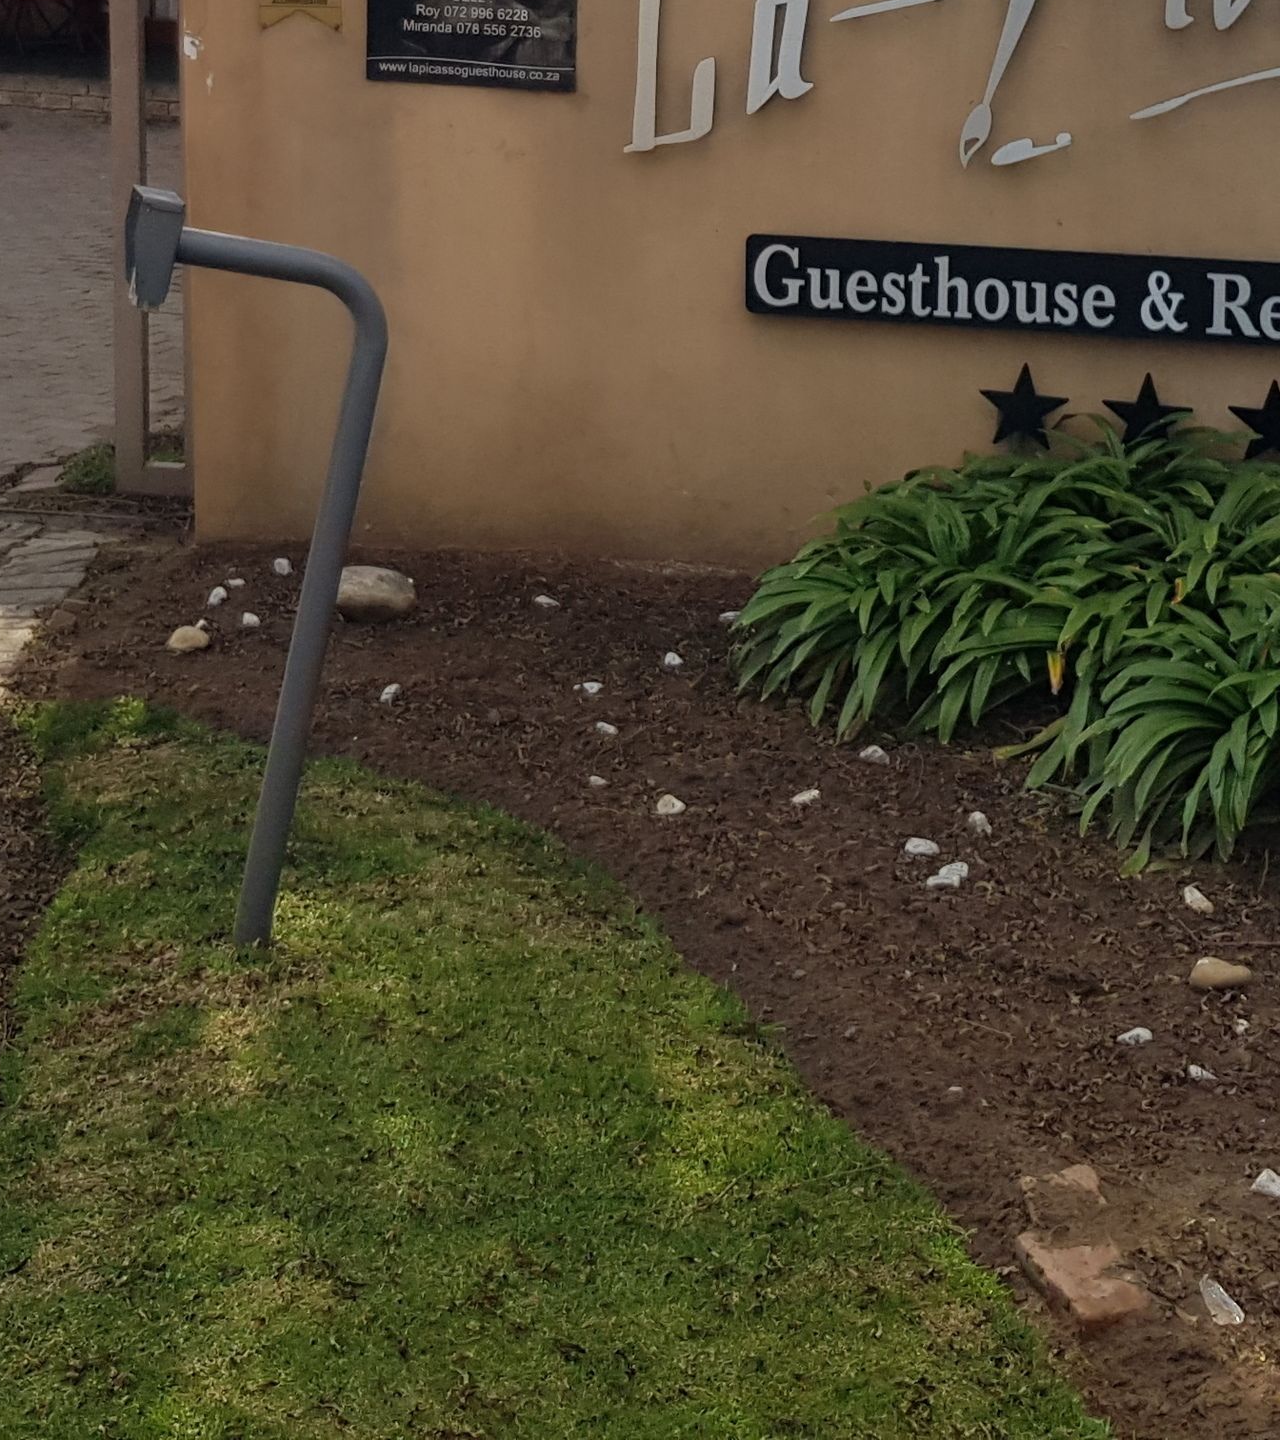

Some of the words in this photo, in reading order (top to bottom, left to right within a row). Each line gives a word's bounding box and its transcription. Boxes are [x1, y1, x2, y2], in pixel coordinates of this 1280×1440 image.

[415, 3, 441, 19] Roy
[444, 5, 468, 18] 072
[471, 7, 494, 20] 996
[497, 8, 529, 21] 6228
[403, 19, 453, 33] Miranda
[456, 22, 480, 34] 078
[483, 23, 507, 36] 556
[510, 25, 541, 38] 2736
[379, 61, 560, 81] wwwlapicassoguesthouse.co.za
[753, 244, 1116, 328] Guesthouse
[1139, 270, 1188, 332] &
